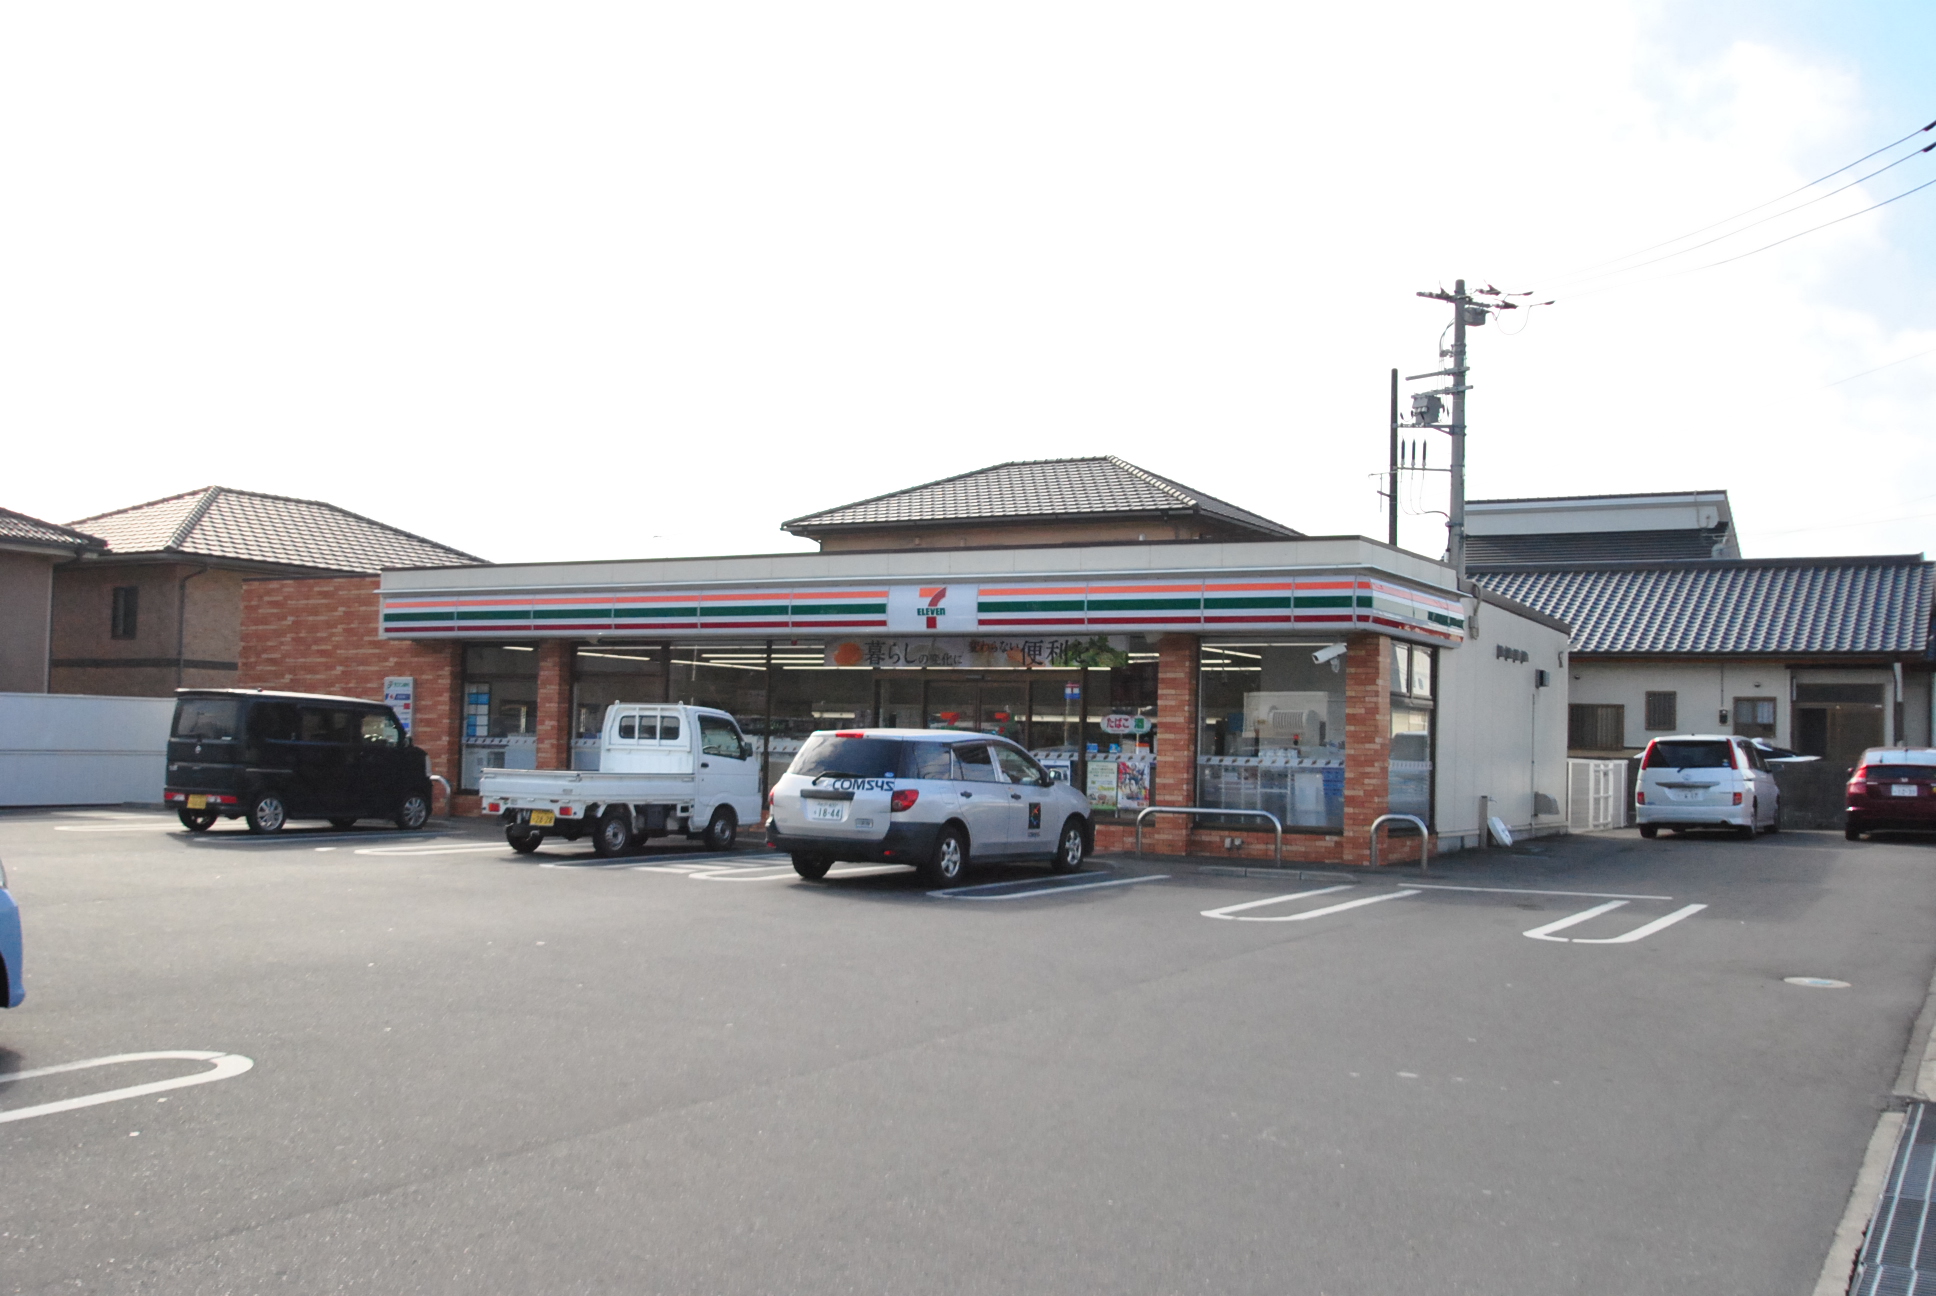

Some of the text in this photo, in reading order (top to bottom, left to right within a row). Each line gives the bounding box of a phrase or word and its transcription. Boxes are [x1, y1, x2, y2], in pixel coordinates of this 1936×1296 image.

[919, 586, 947, 629] 7
[1106, 717, 1129, 728] たばこ
[832, 779, 895, 791] COMSYS
